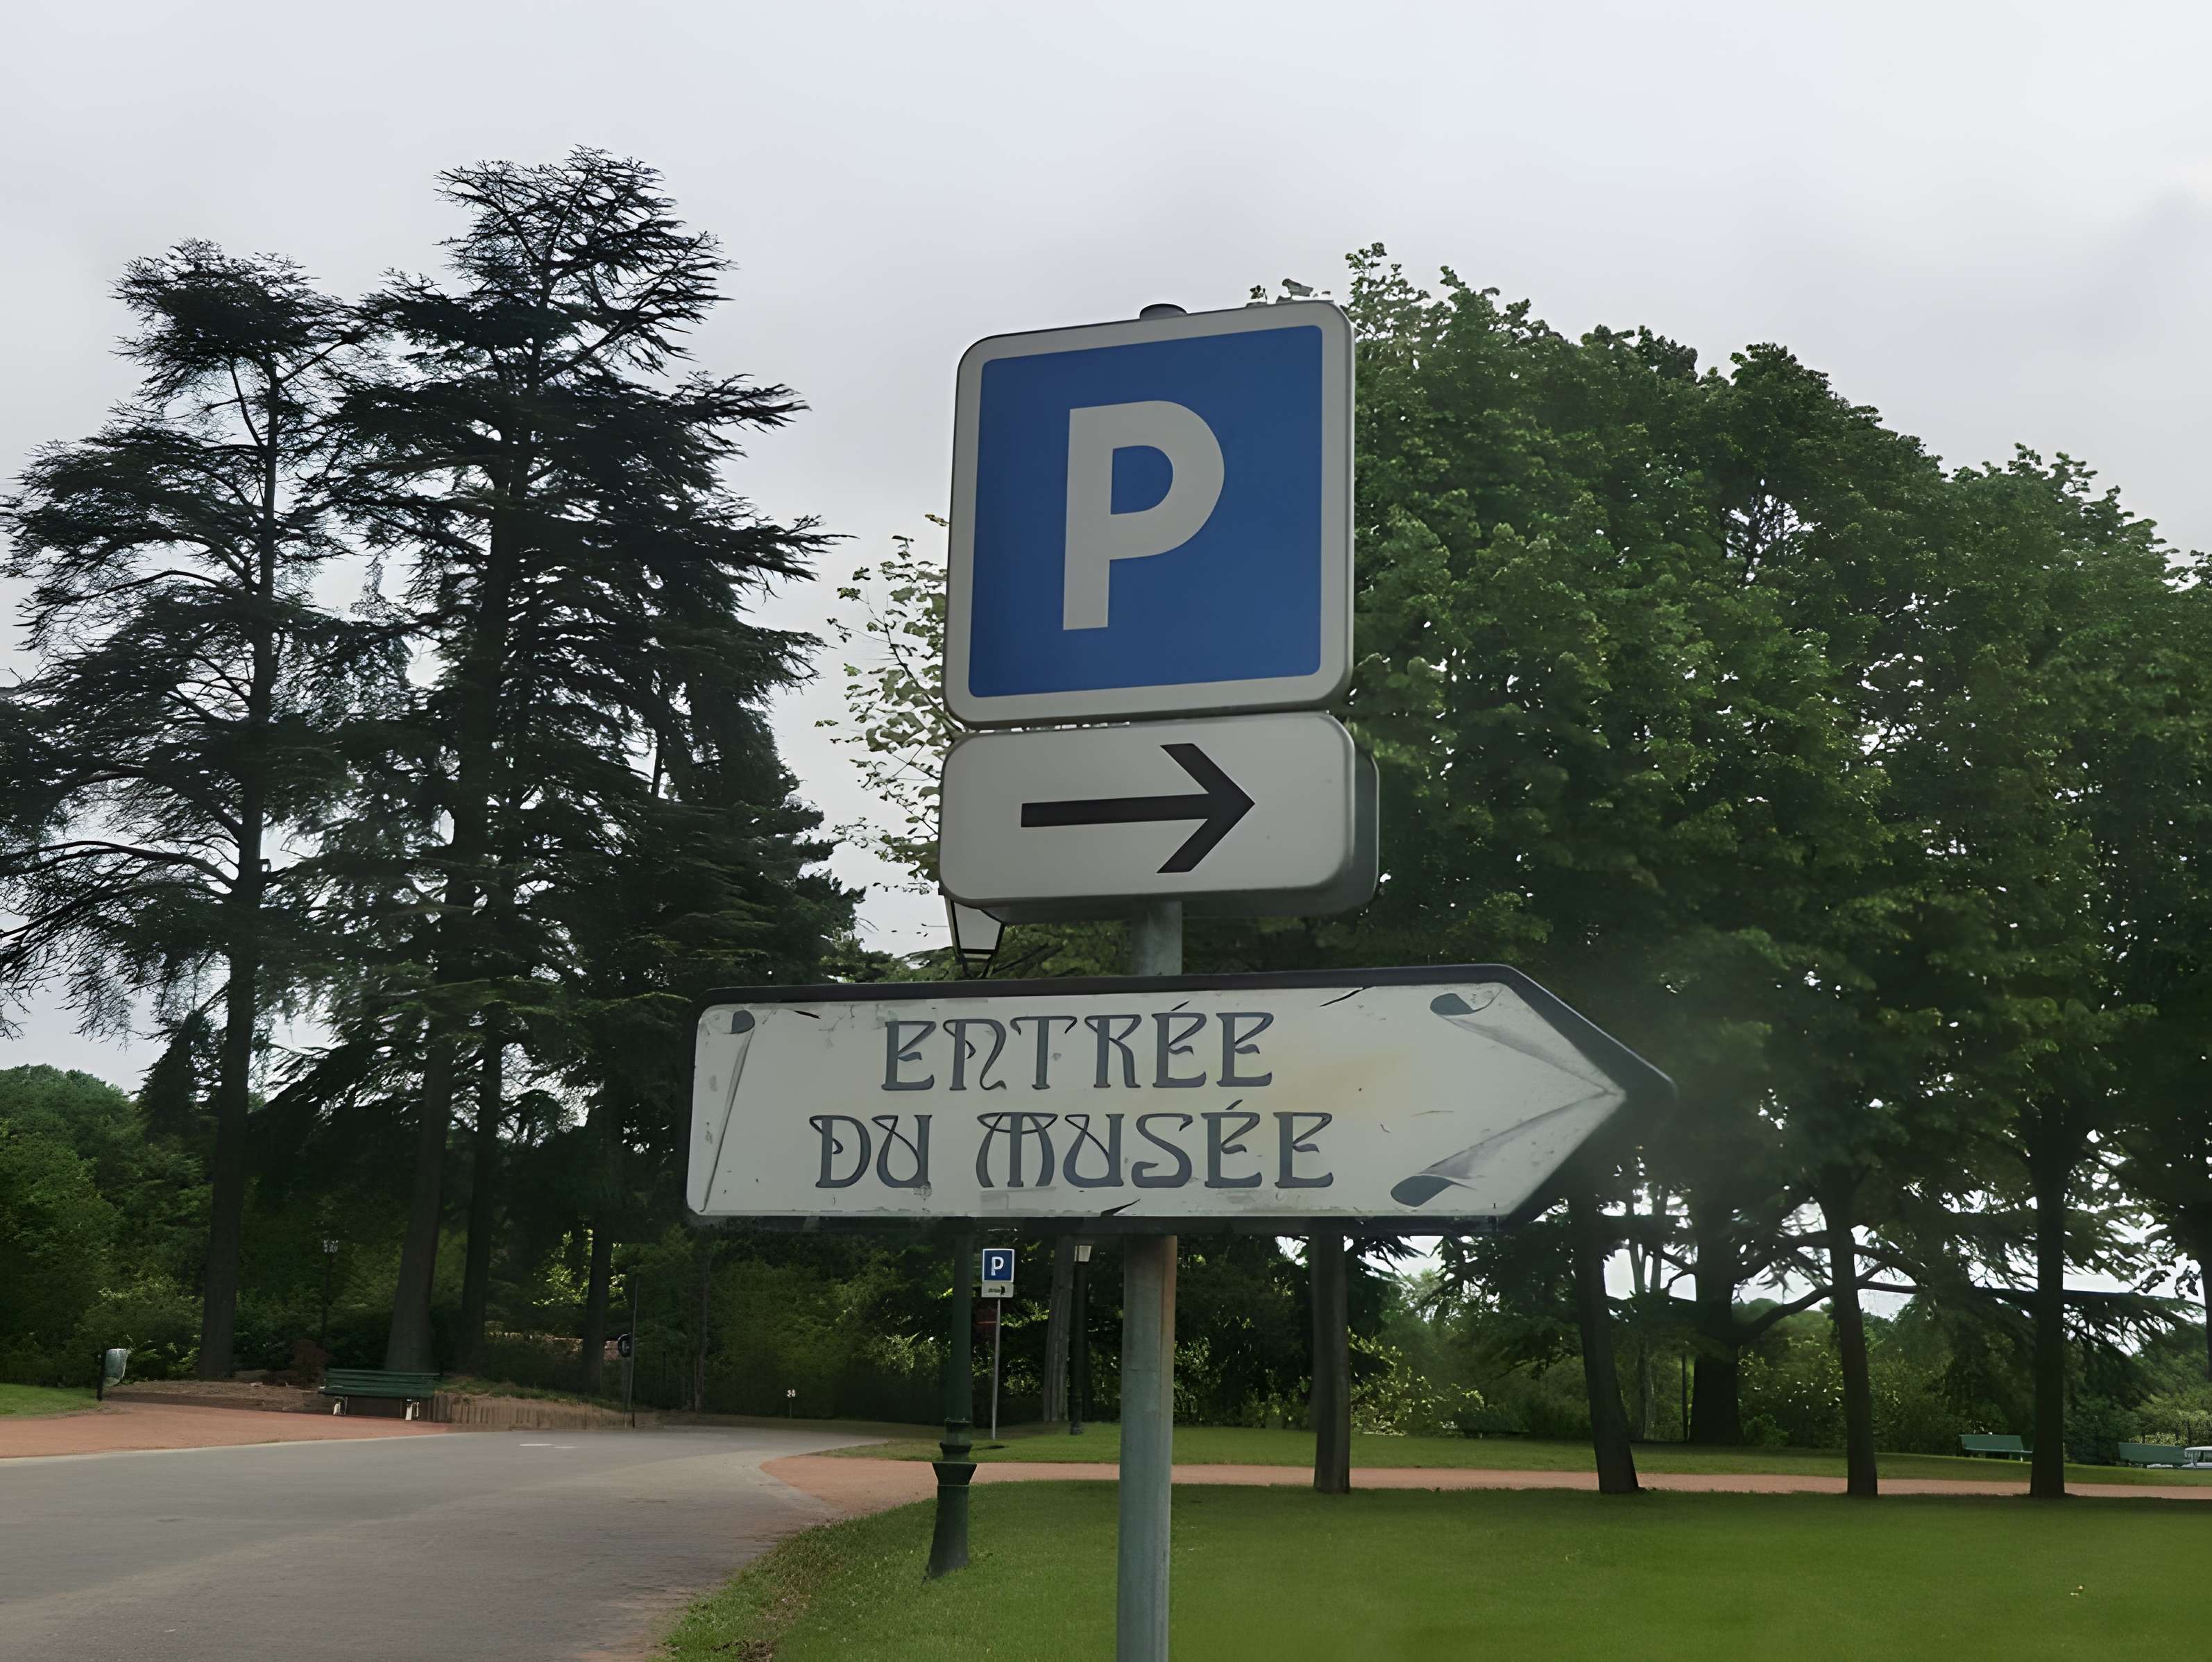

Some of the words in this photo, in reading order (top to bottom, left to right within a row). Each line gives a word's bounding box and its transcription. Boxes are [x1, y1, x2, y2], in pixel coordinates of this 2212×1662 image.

[1063, 400, 1225, 630] P
[881, 1001, 1274, 1091] ENTRÉE
[808, 1113, 932, 1189] DU
[975, 1100, 1334, 1189] MUSÉE
[991, 1256, 1004, 1276] P
